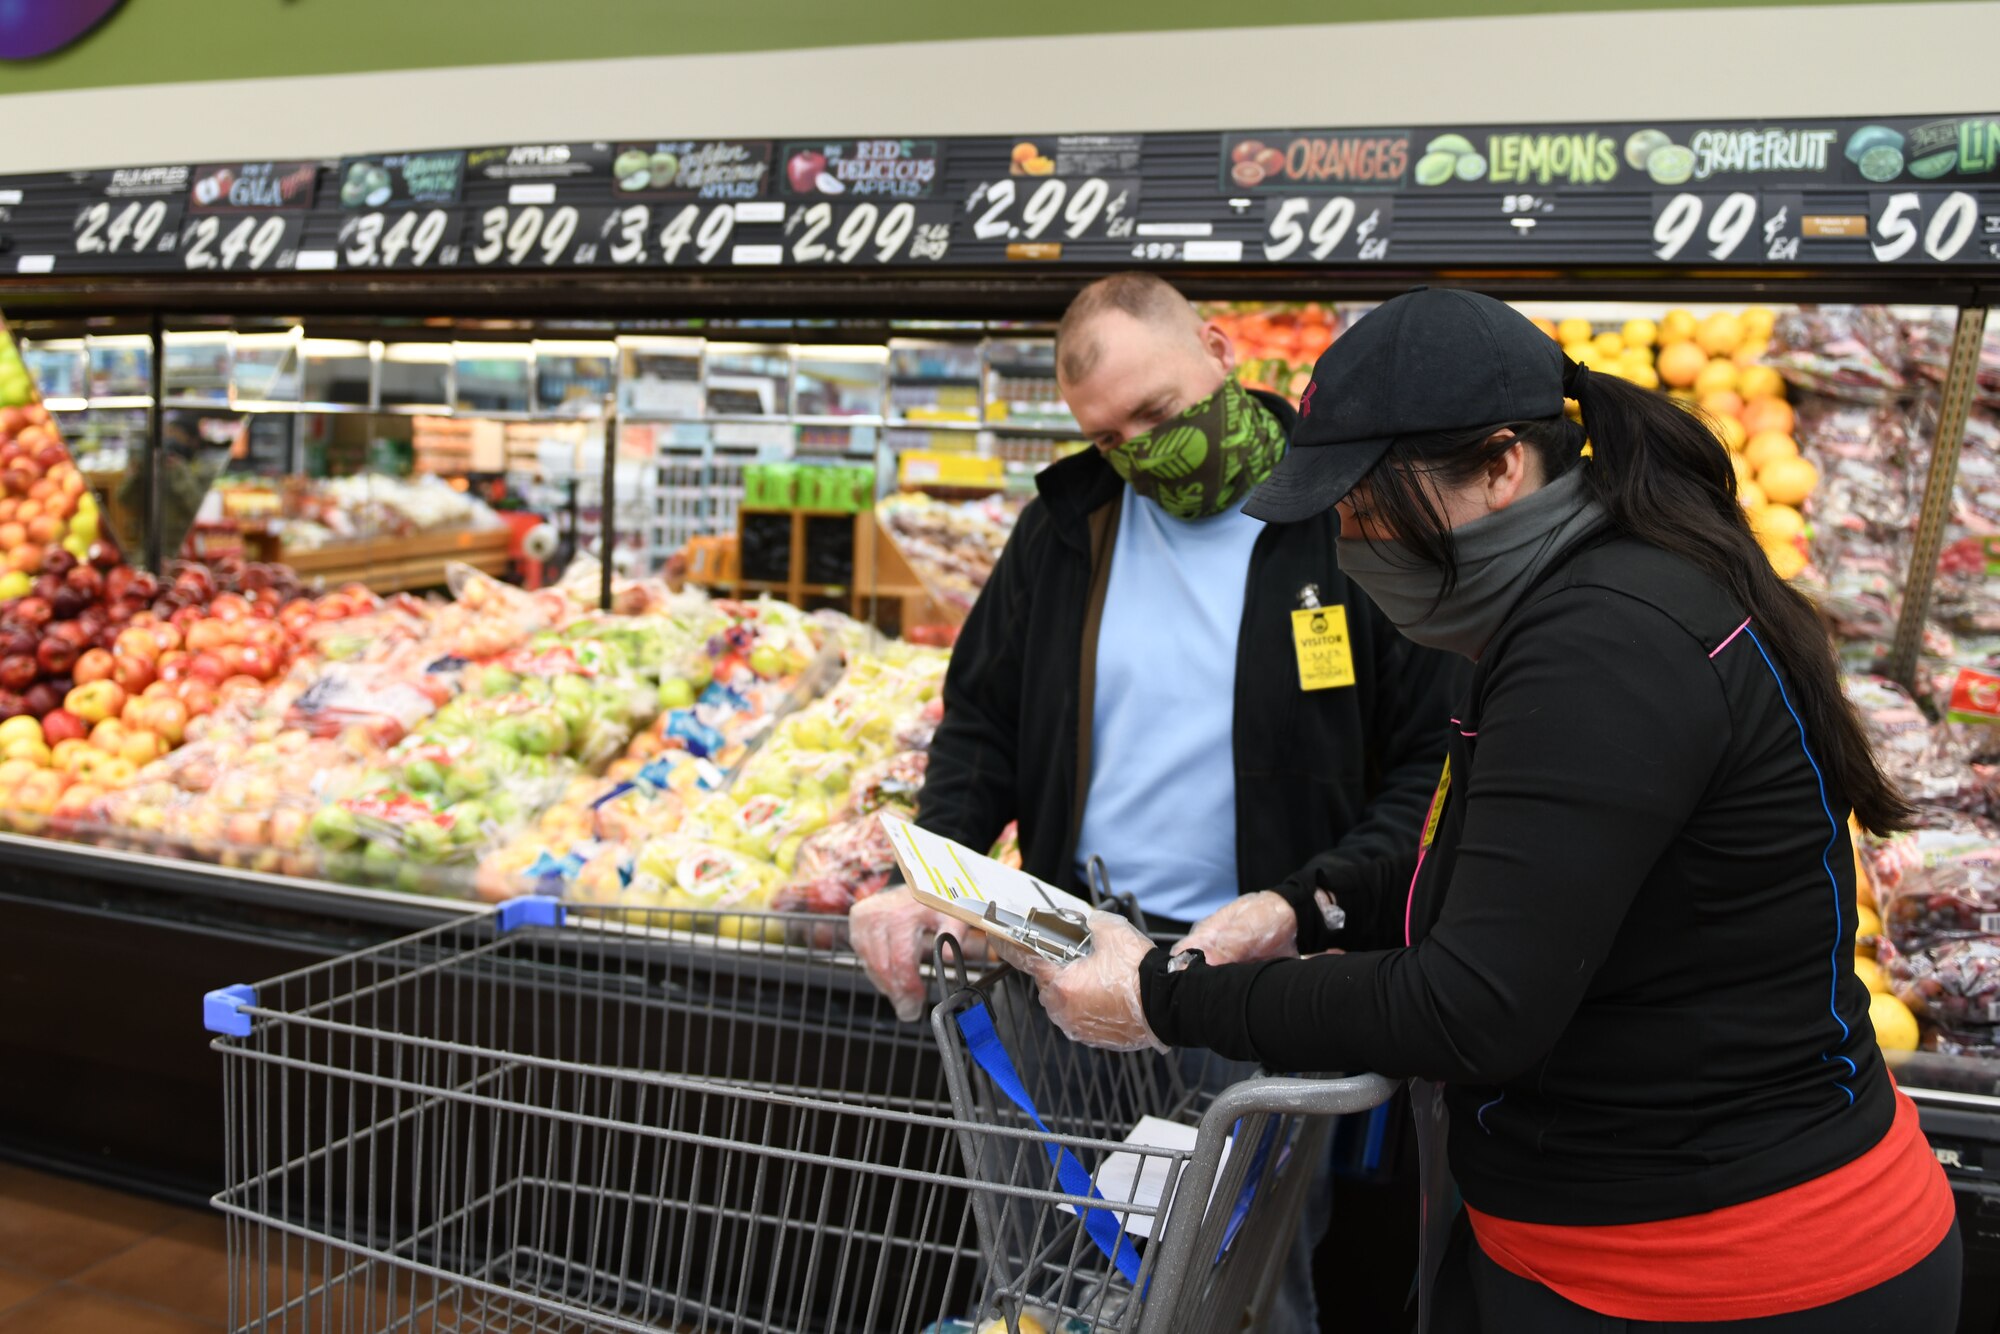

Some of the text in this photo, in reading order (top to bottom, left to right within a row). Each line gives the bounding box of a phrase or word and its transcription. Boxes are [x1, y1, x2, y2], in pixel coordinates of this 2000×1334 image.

[856, 140, 902, 159] RED
[1285, 137, 1409, 182] ORANGES
[1488, 132, 1617, 184] LEMONS
[1692, 128, 1837, 179] GRAPEFRUIT
[837, 158, 936, 182] DELICIOUS
[851, 179, 921, 198] APPLES
[1872, 191, 1979, 262] 50
[1301, 635, 1342, 647] VISITOR
[1931, 1147, 1962, 1168] ER
